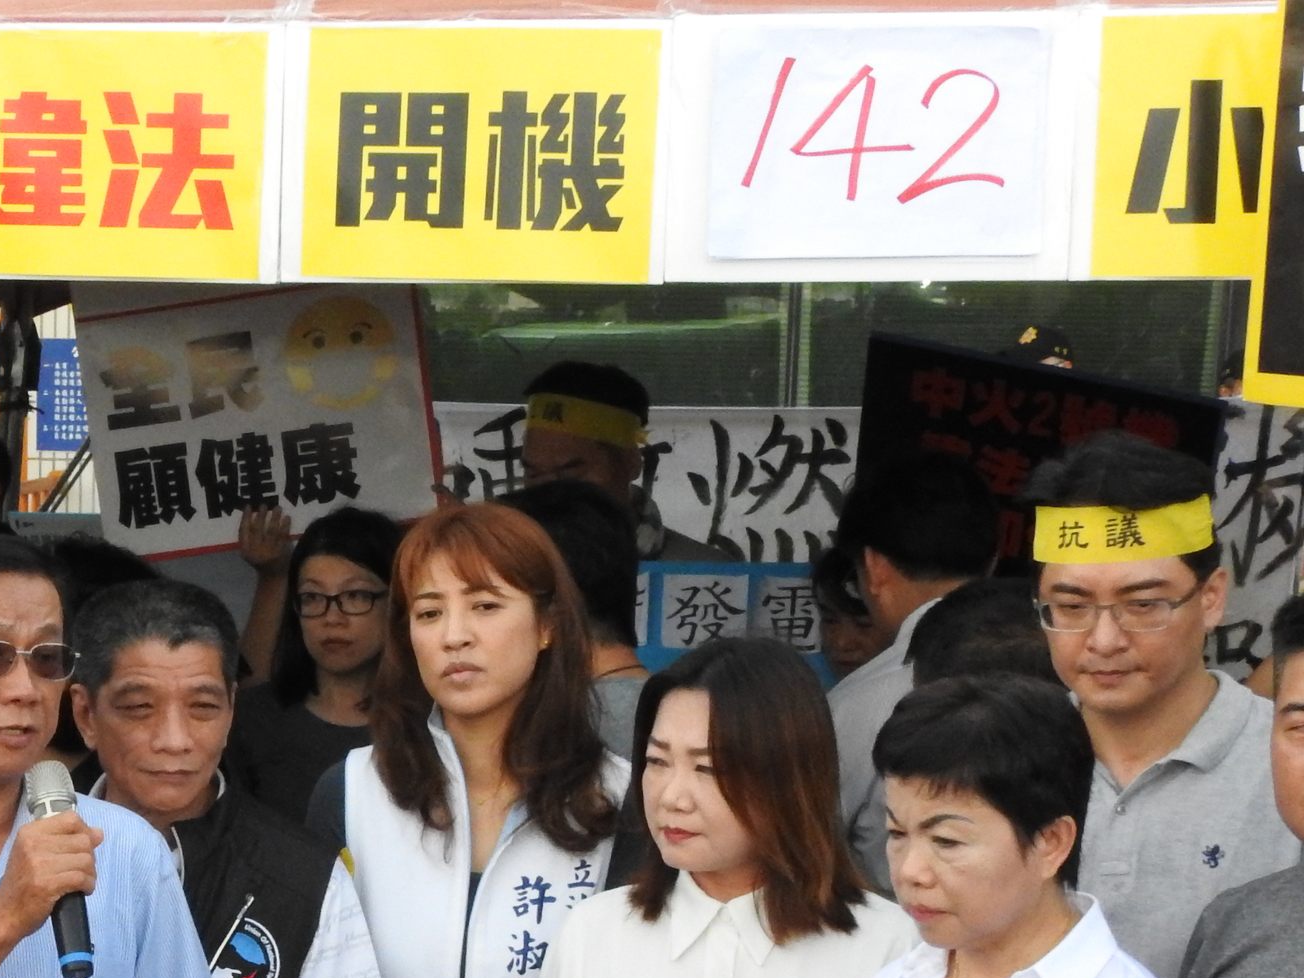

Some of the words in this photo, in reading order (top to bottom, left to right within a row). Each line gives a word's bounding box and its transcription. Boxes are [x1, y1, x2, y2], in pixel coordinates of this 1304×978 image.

[336, 90, 627, 233] 開機
[740, 56, 1005, 204] 142
[1126, 79, 1264, 225] 小
[113, 422, 361, 529] 顧健康
[1058, 513, 1146, 549] 抗議
[634, 580, 818, 654] 發電
